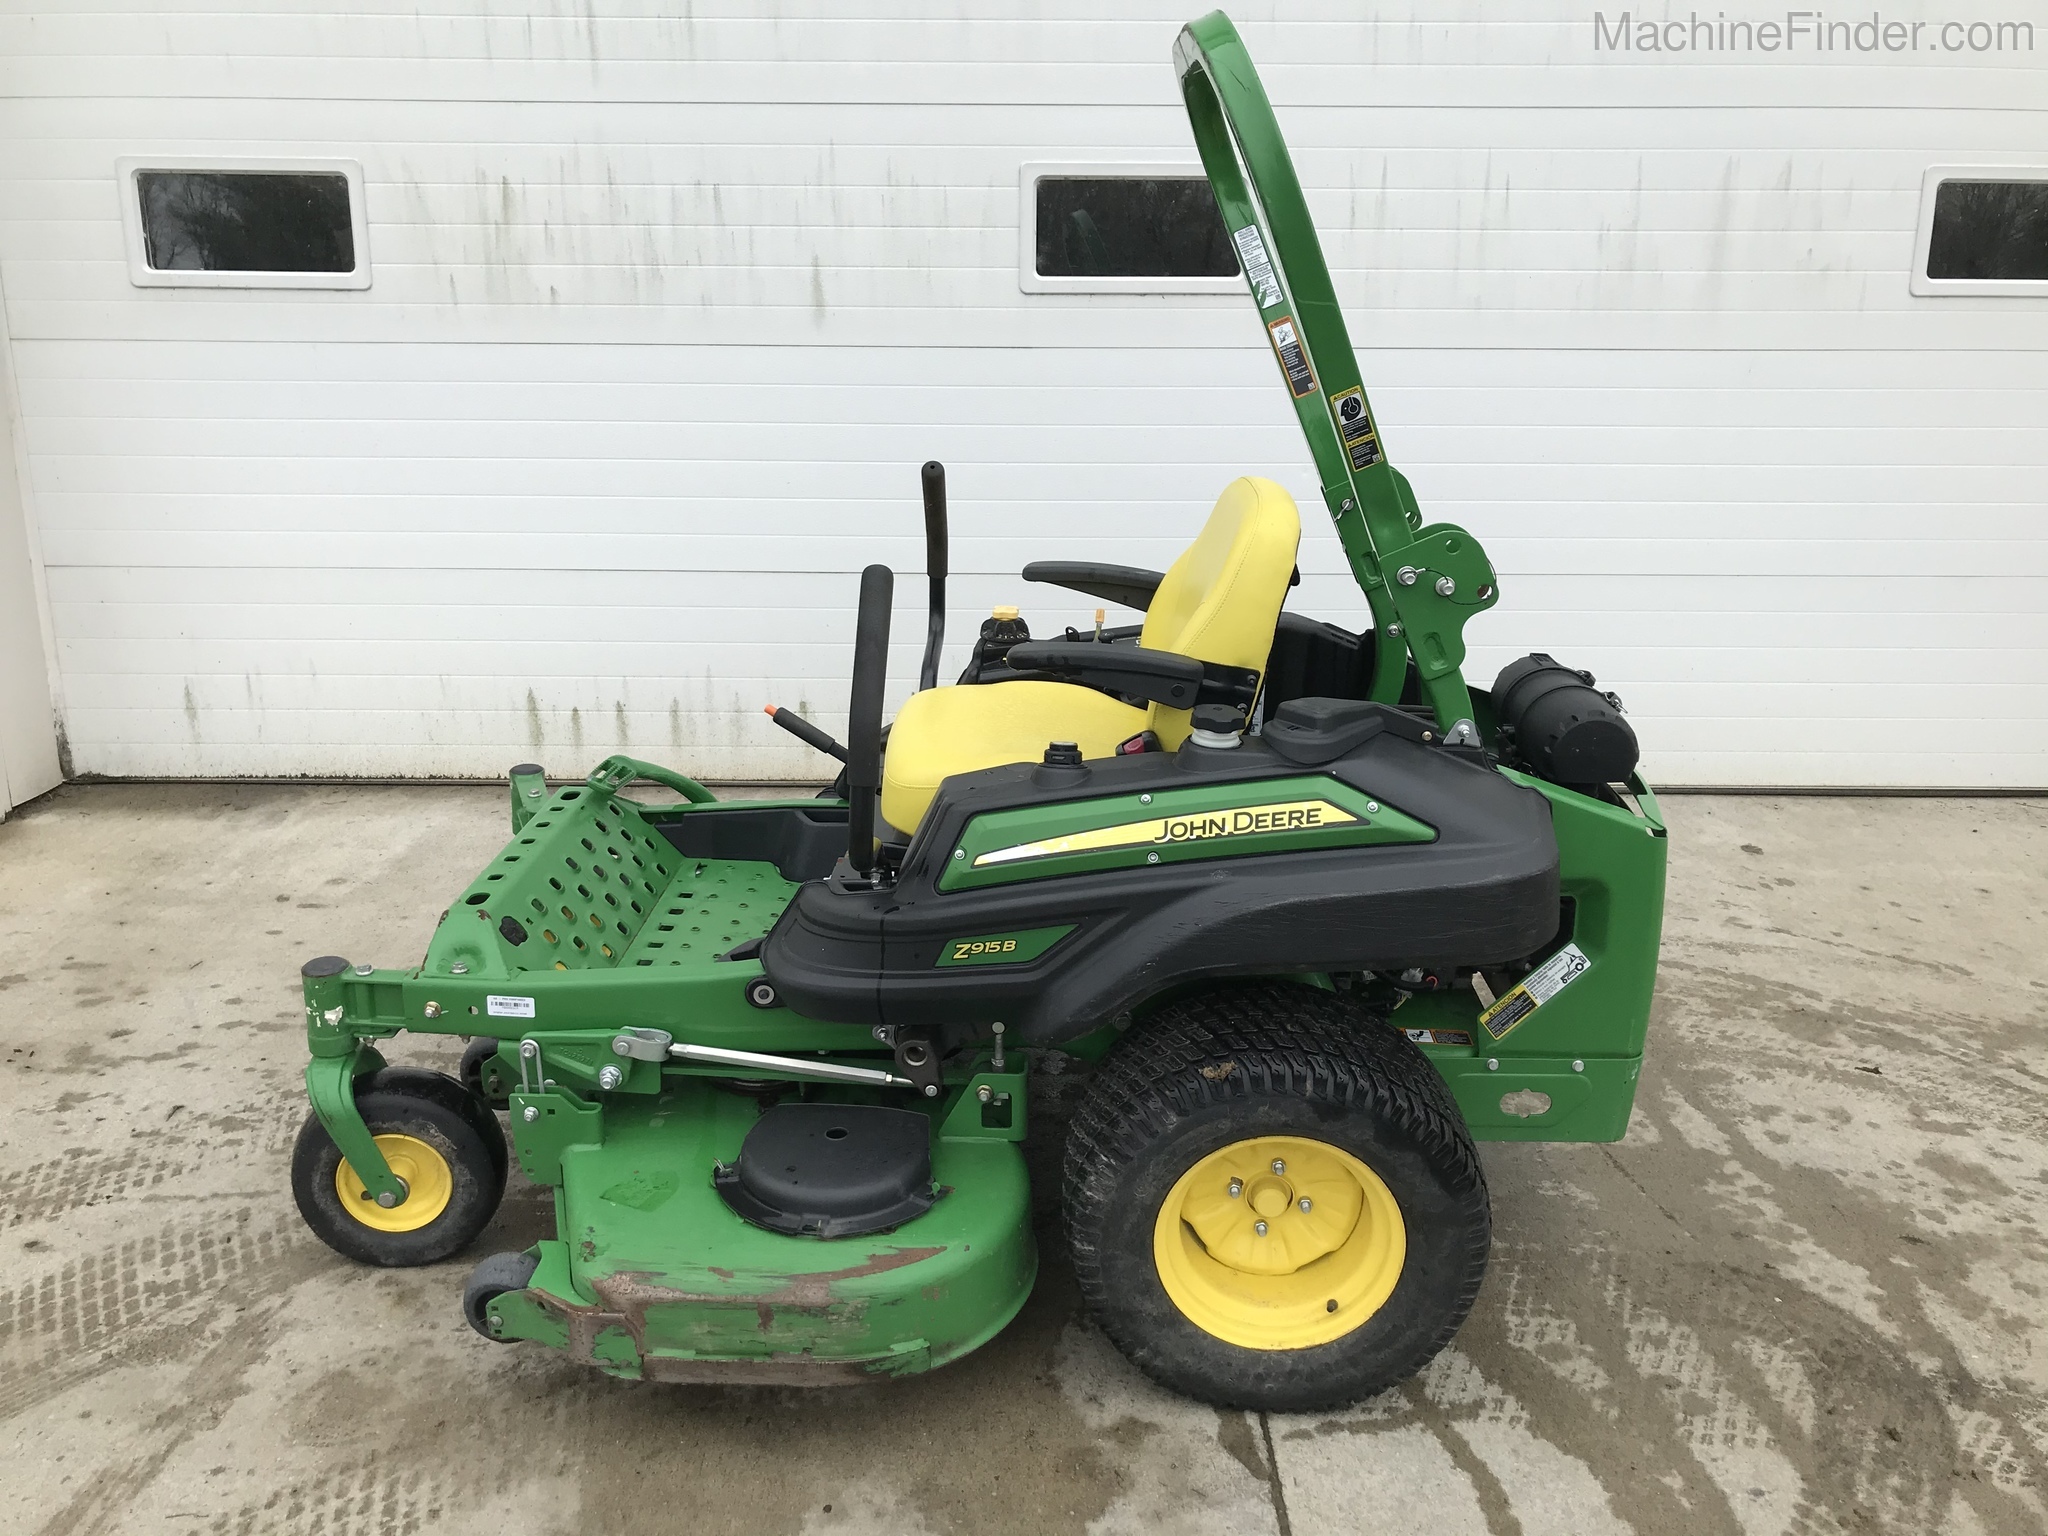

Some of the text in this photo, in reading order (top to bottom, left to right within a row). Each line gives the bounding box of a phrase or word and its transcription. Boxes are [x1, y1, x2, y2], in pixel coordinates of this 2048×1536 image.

[1337, 387, 1359, 399] CAUTION
[1154, 807, 1322, 841] JOHN DEERE
[952, 939, 1017, 960] Z915B
